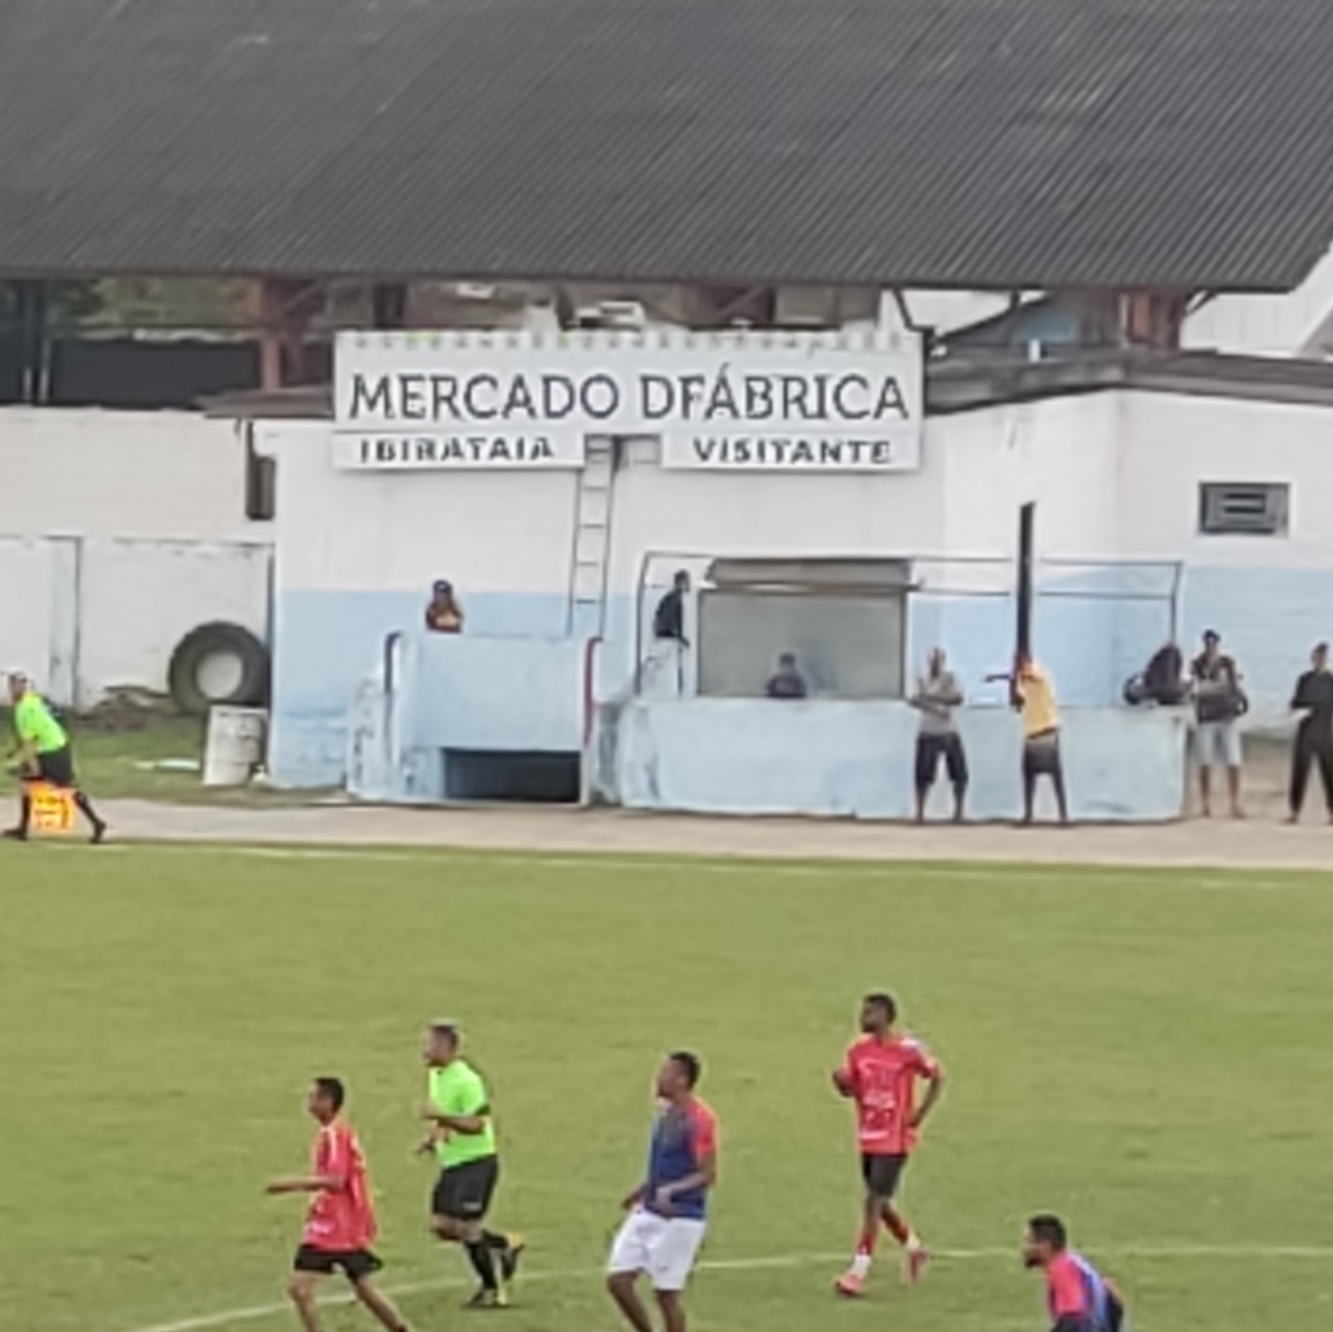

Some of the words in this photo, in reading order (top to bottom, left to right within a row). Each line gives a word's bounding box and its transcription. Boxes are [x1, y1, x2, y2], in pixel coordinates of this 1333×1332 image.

[348, 372, 621, 421] MERCADO
[359, 436, 555, 463] IBIRATAIA
[692, 437, 891, 465] VISITANTE
